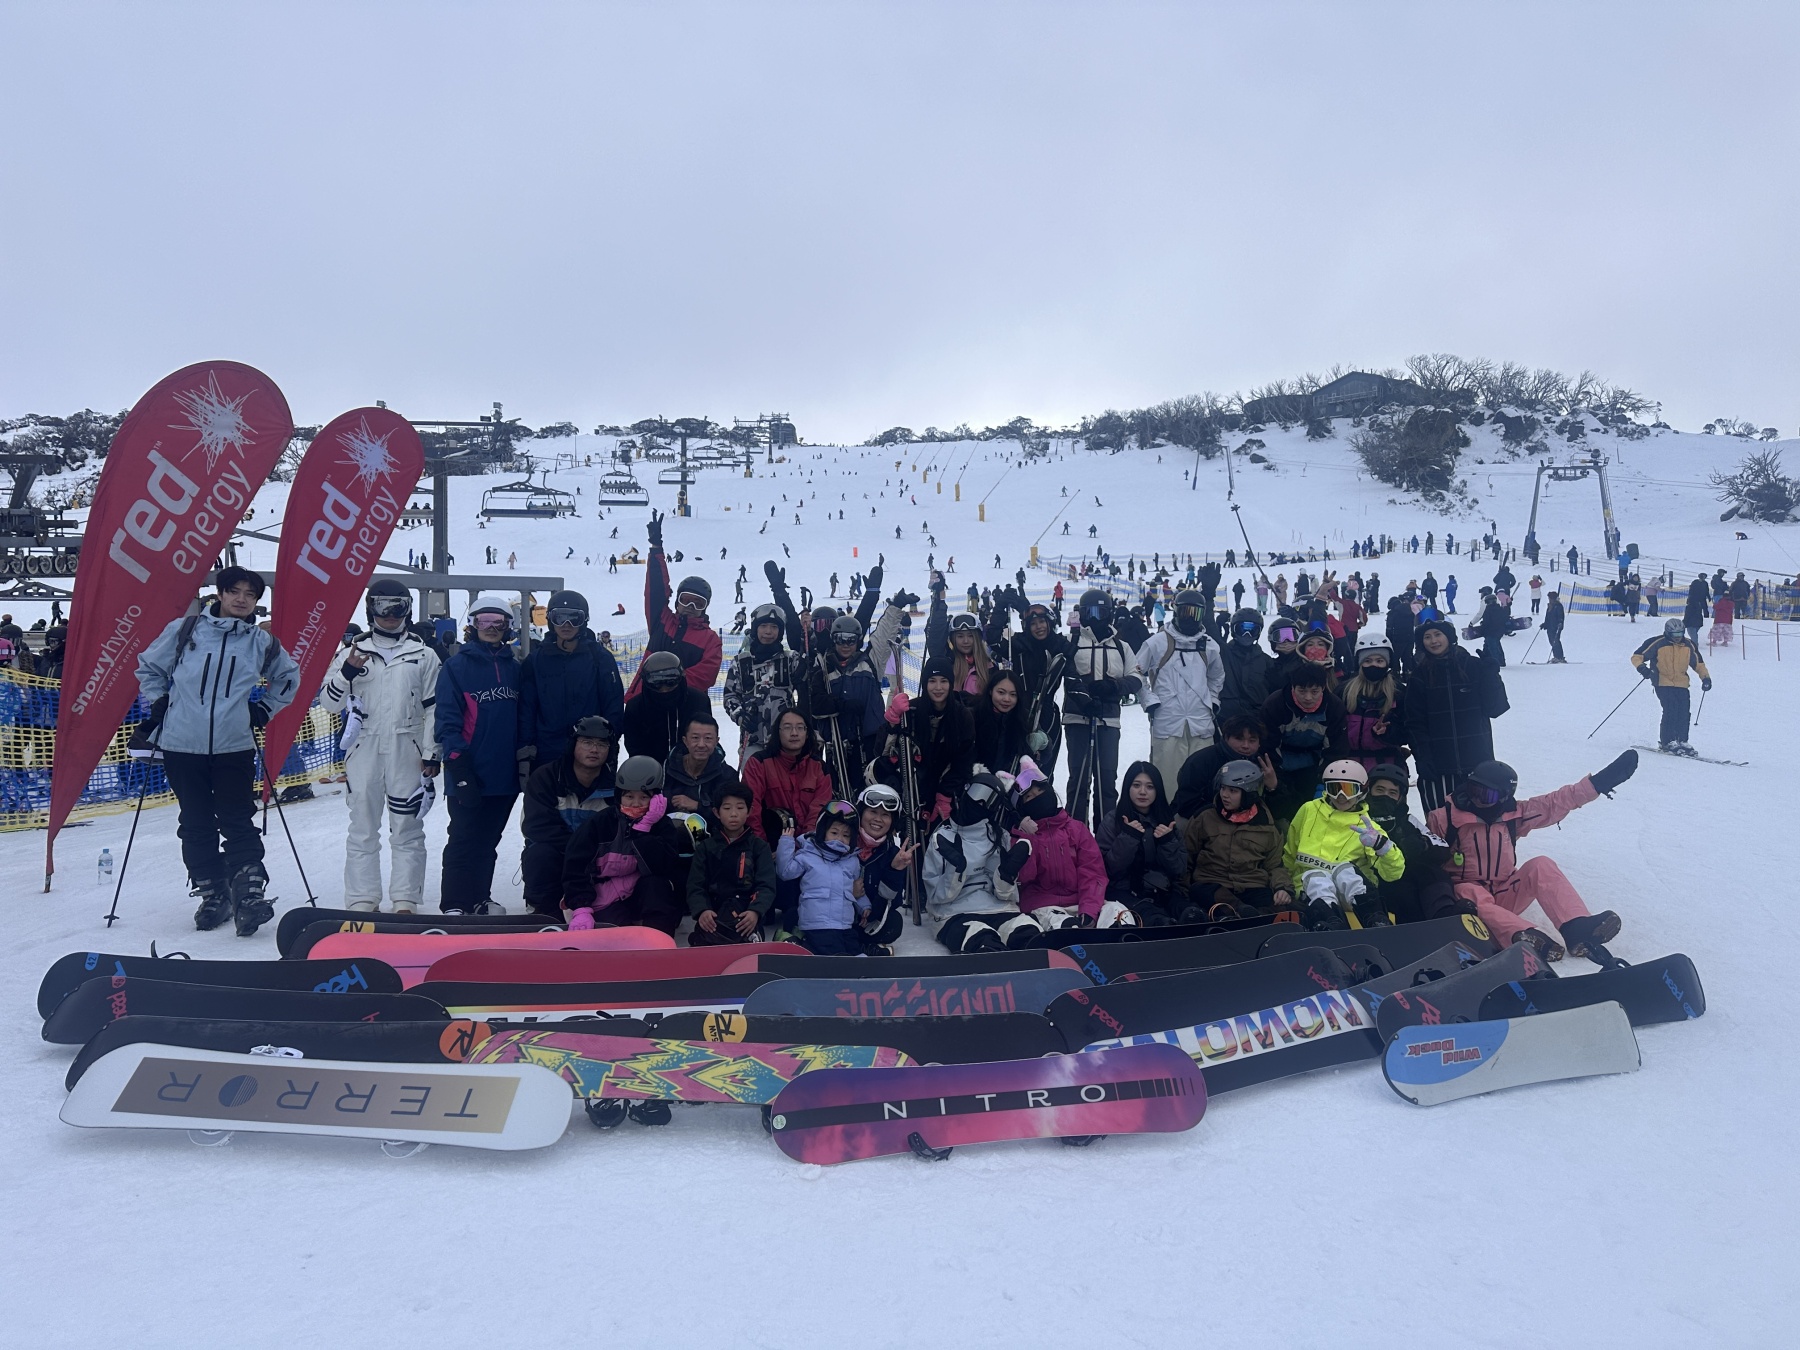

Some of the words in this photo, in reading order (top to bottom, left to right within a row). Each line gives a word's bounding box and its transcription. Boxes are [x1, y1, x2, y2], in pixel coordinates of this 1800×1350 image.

[109, 450, 200, 584] red
[172, 460, 252, 574] energy
[296, 480, 362, 585] red
[344, 485, 400, 576] energy
[71, 605, 142, 715] snowyhydro
[97, 664, 123, 704] renewable
[122, 637, 141, 664] energy
[1662, 969, 1684, 1002] head
[1089, 1004, 1124, 1037] head
[1406, 1039, 1455, 1057] Duck
[1442, 1047, 1482, 1065] Wild
[883, 1084, 1106, 1120] NITRO
